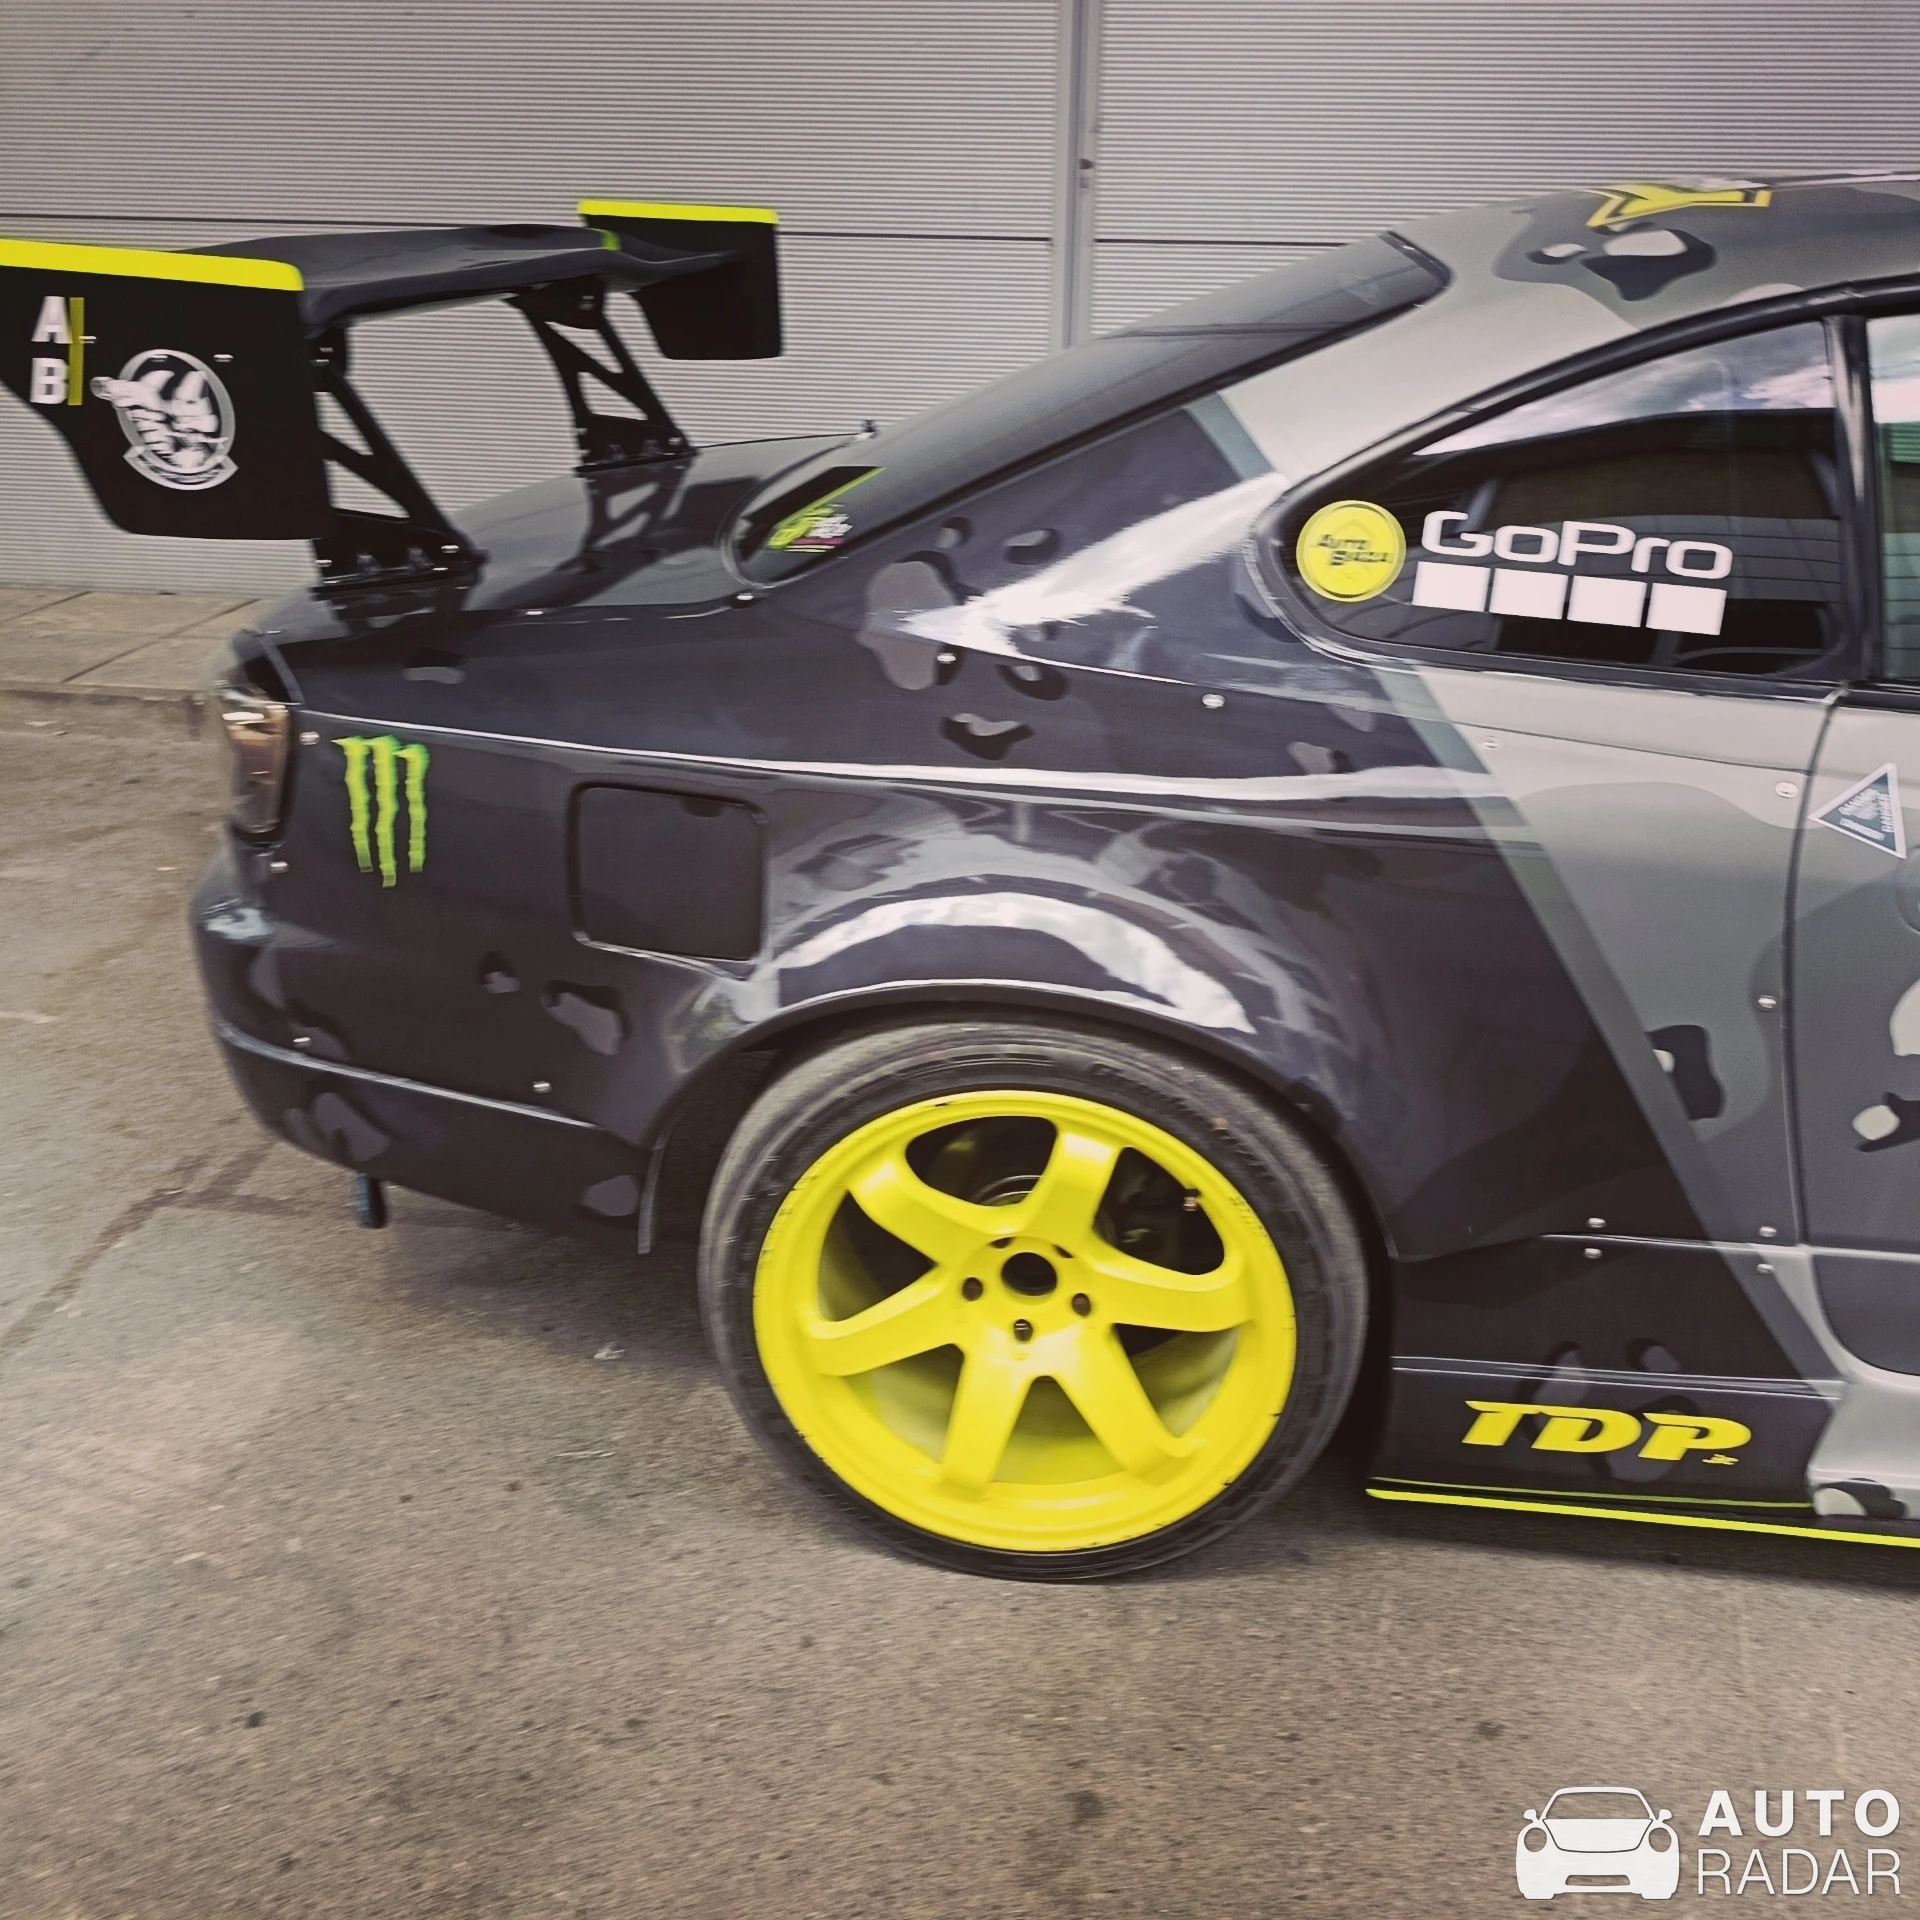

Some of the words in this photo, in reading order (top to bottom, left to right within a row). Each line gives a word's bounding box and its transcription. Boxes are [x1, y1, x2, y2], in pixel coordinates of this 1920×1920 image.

[31, 296, 73, 344] A
[30, 357, 69, 404] B
[1421, 510, 1733, 580] GoPro
[1461, 1400, 1752, 1461] TDP
